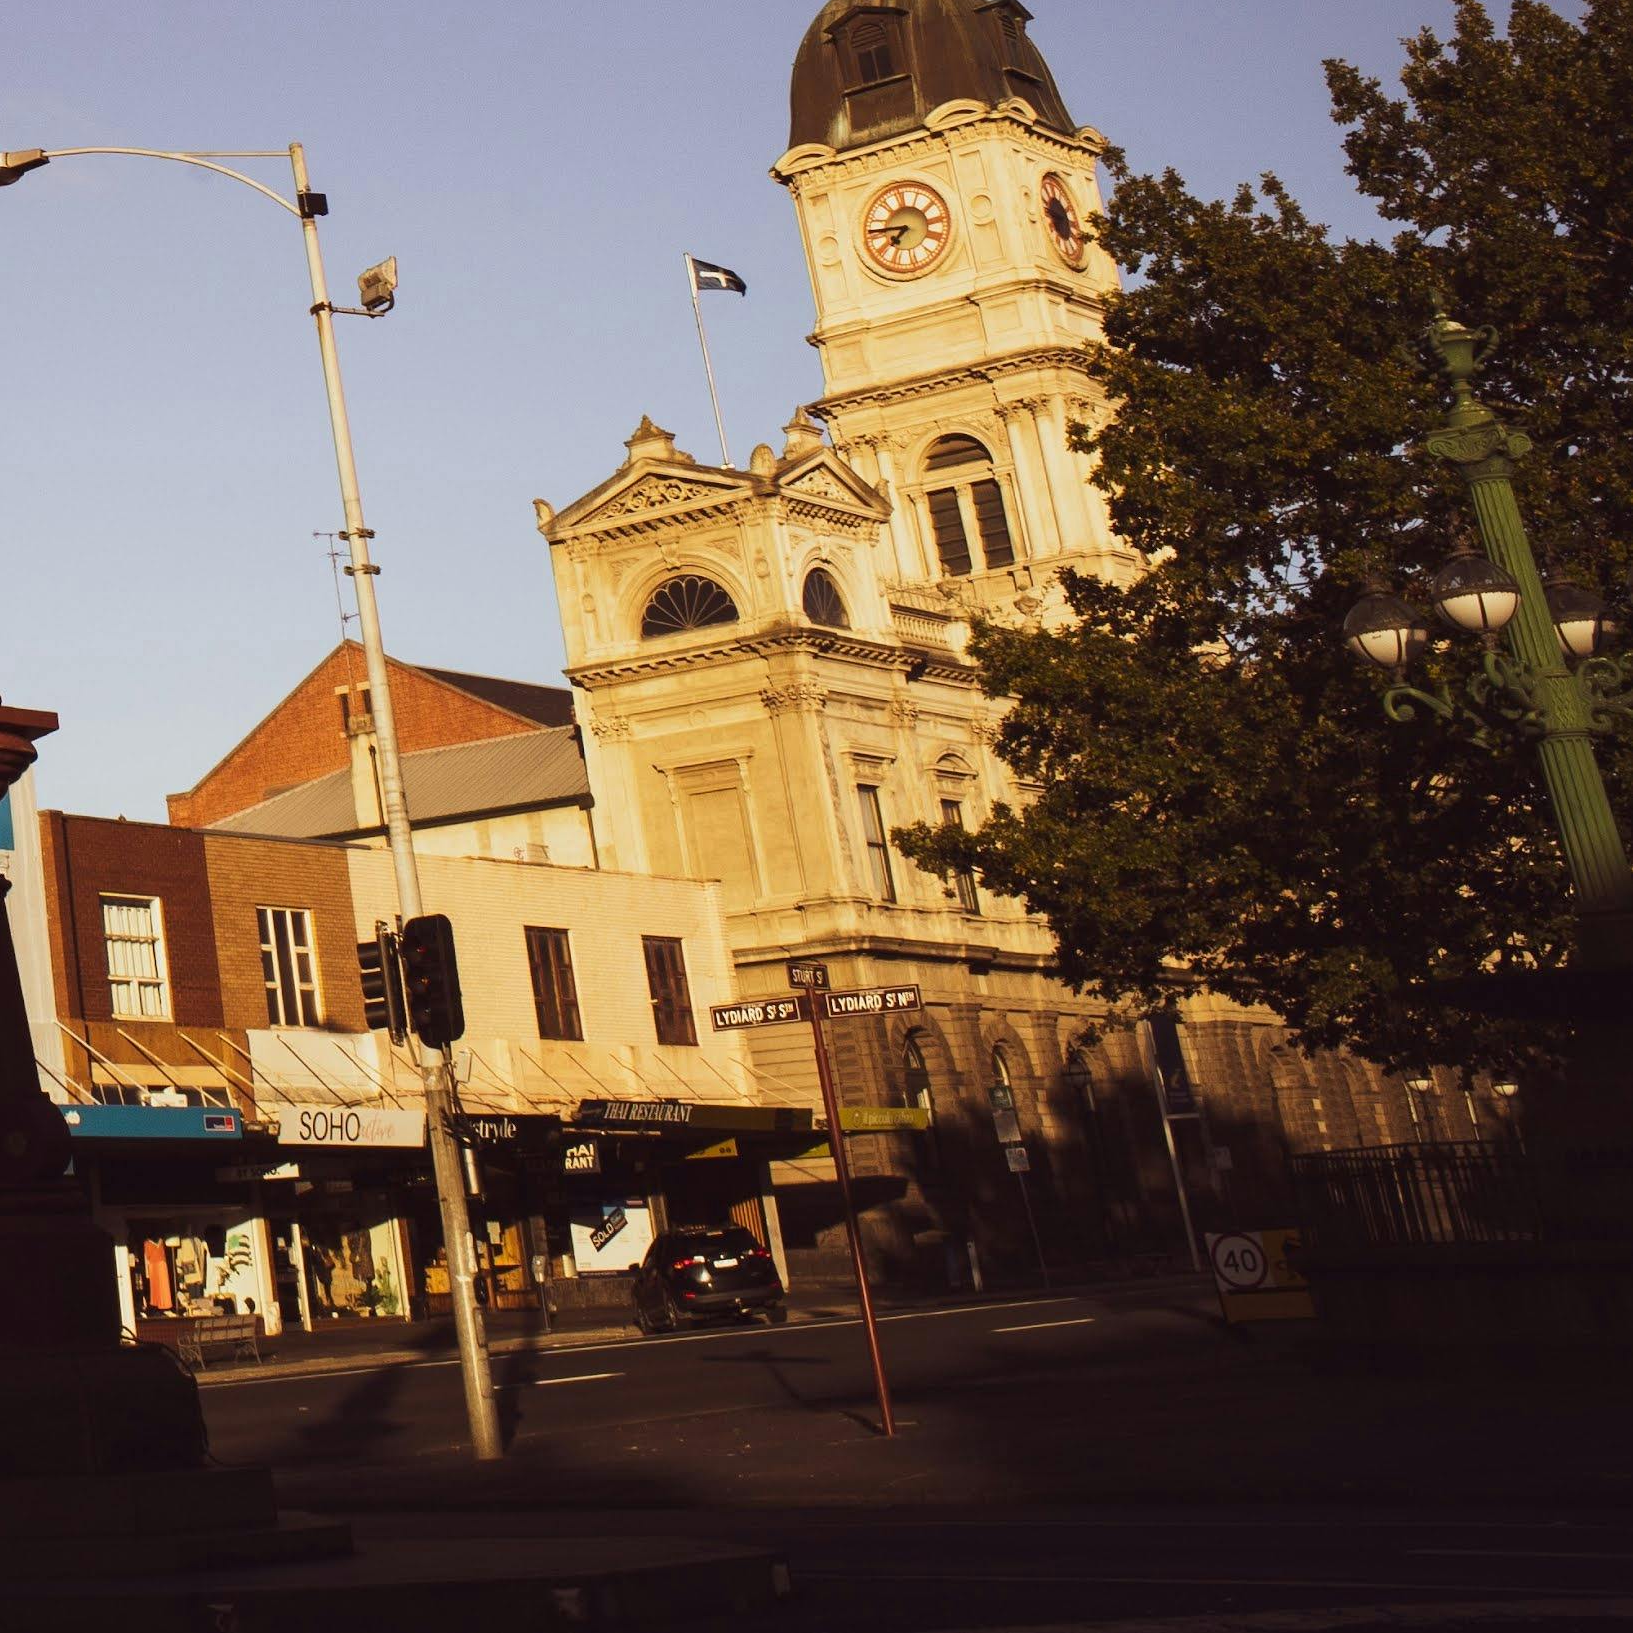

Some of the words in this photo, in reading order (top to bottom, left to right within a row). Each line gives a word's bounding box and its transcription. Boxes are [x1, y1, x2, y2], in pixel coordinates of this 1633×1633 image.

[792, 968, 814, 984] STURT
[831, 994, 882, 1013] LYDIARD
[716, 1007, 764, 1026] LYDIARD
[603, 1102, 630, 1120] THAI
[628, 1103, 694, 1123] RESTAURANT
[299, 1111, 361, 1142] SOHO
[592, 1222, 615, 1248] SOLD
[1224, 1249, 1256, 1273] 40
